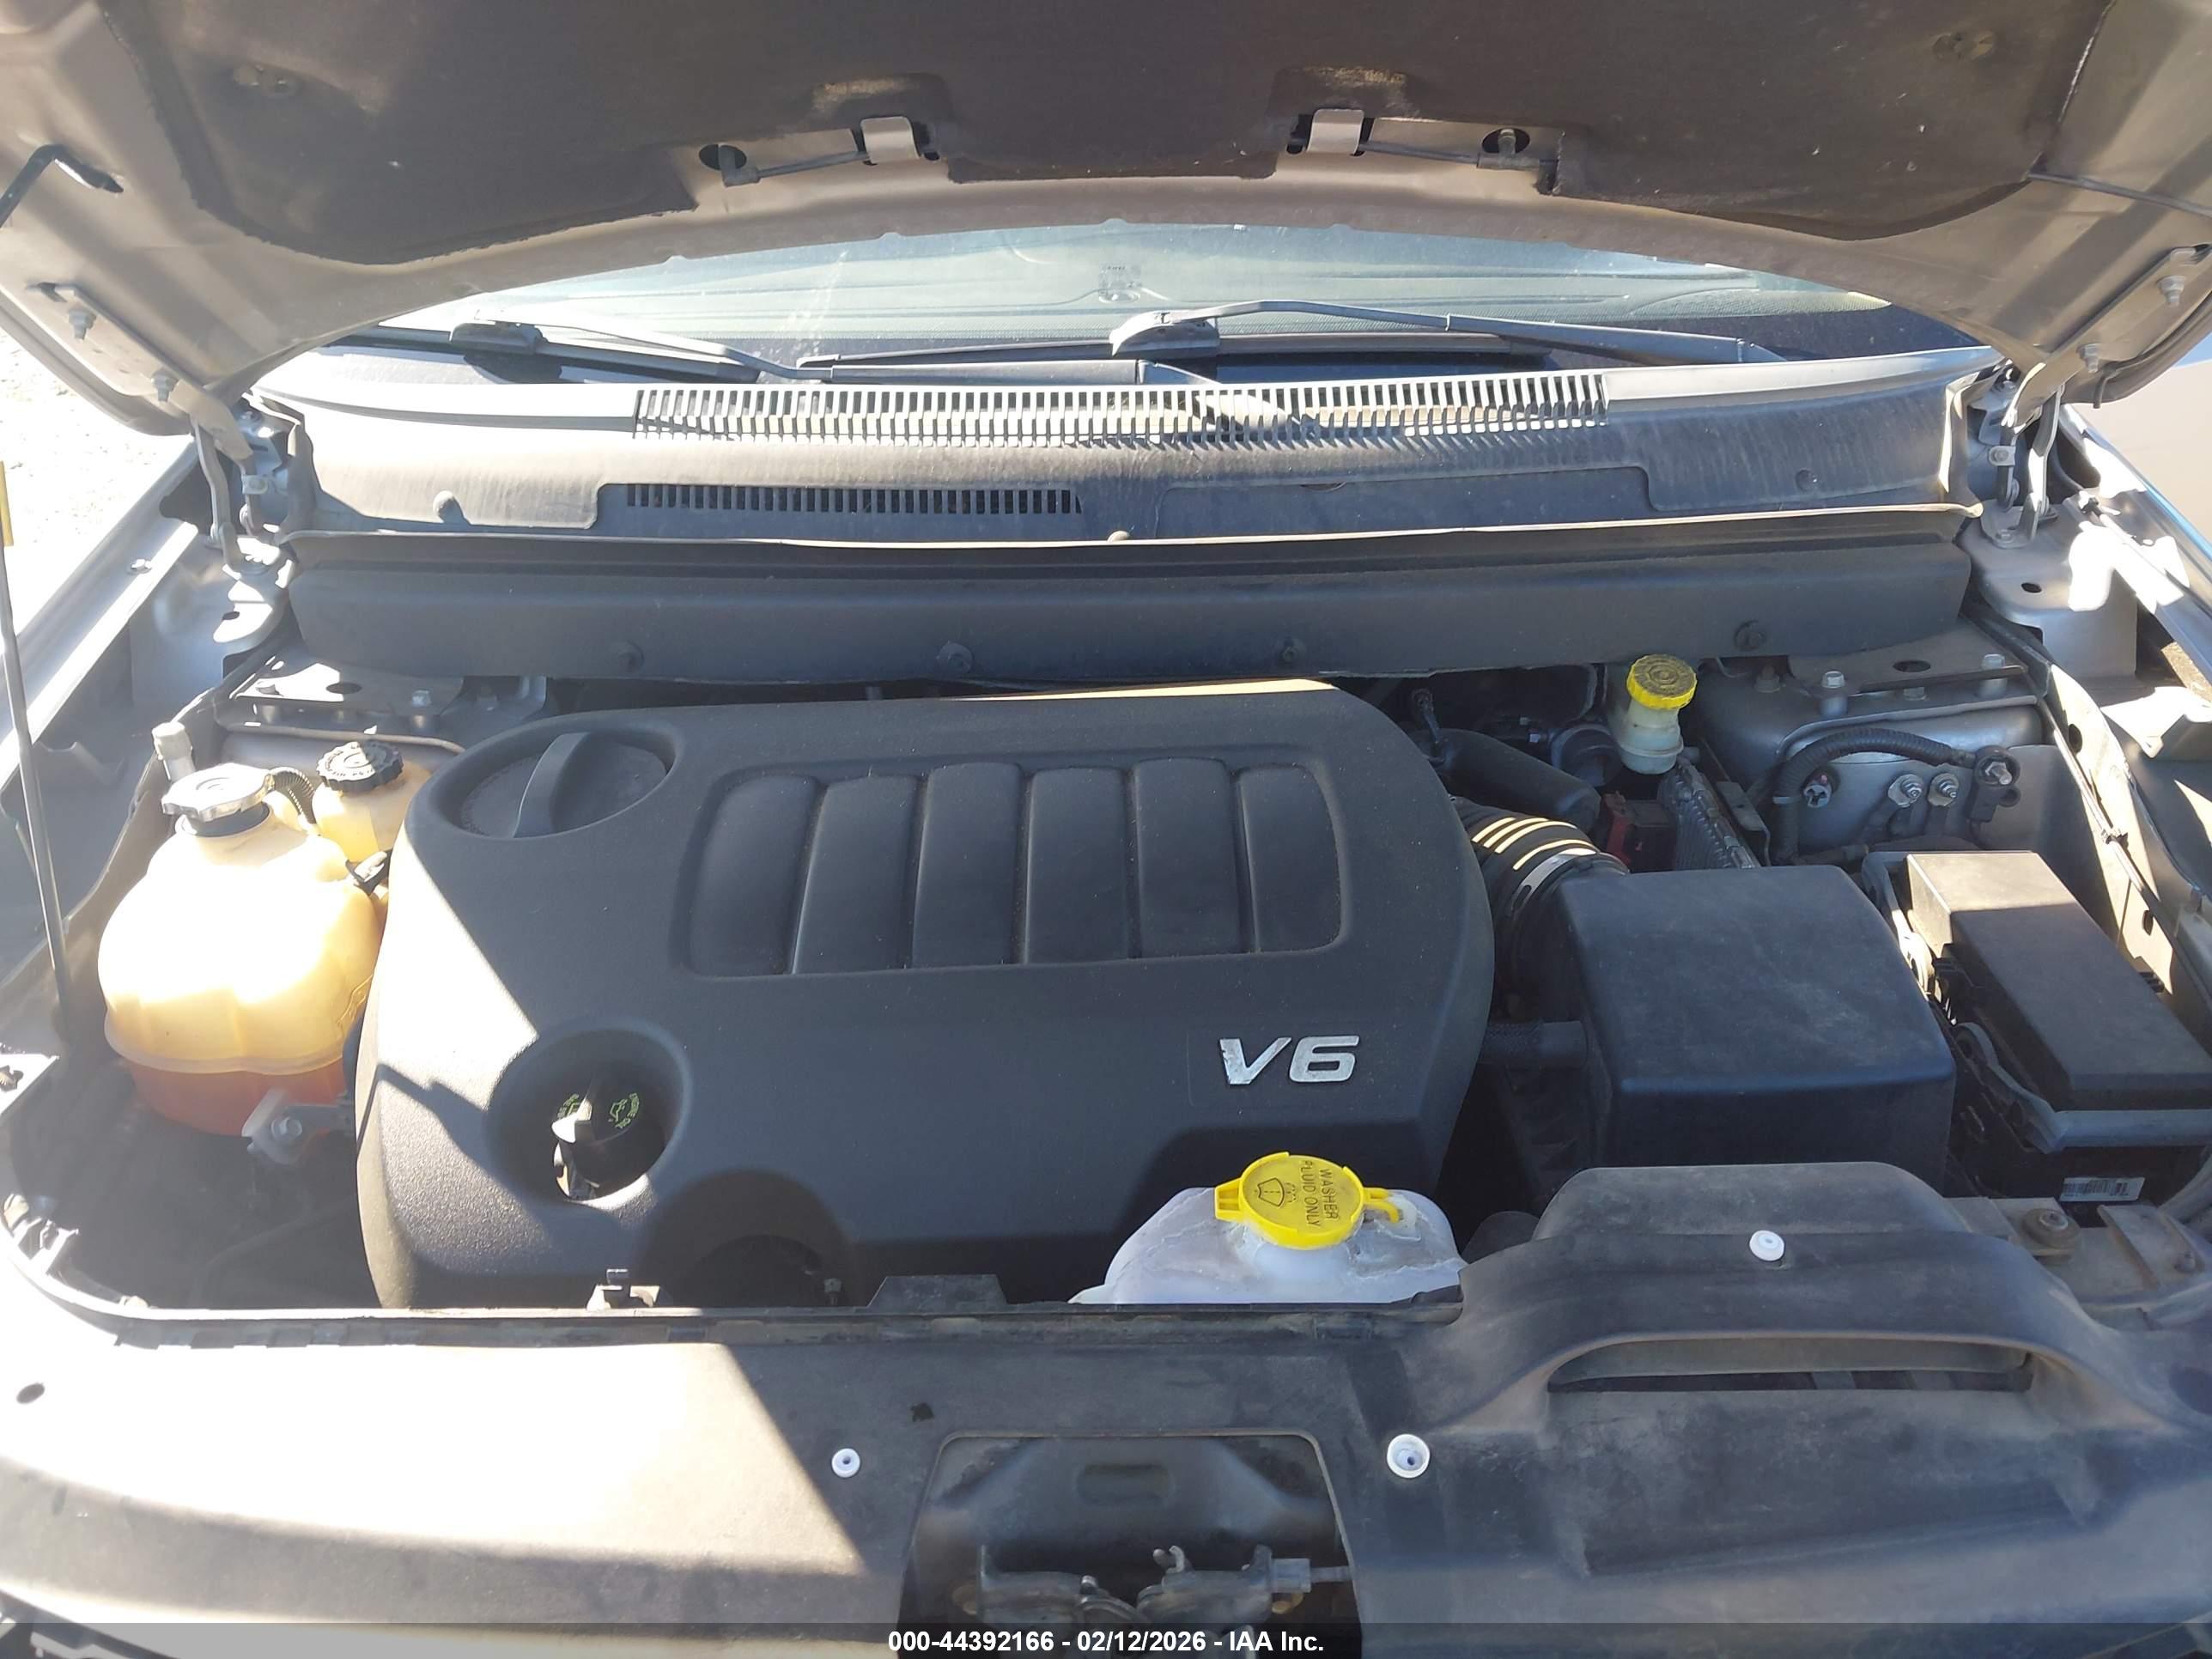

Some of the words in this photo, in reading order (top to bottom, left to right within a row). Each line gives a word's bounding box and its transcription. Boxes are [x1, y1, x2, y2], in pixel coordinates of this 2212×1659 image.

[1219, 1036, 1360, 1085] V6
[1300, 1160, 1316, 1193] FLUID
[1320, 1168, 1340, 1219] WASHER
[1304, 1196, 1322, 1227] ONLY
